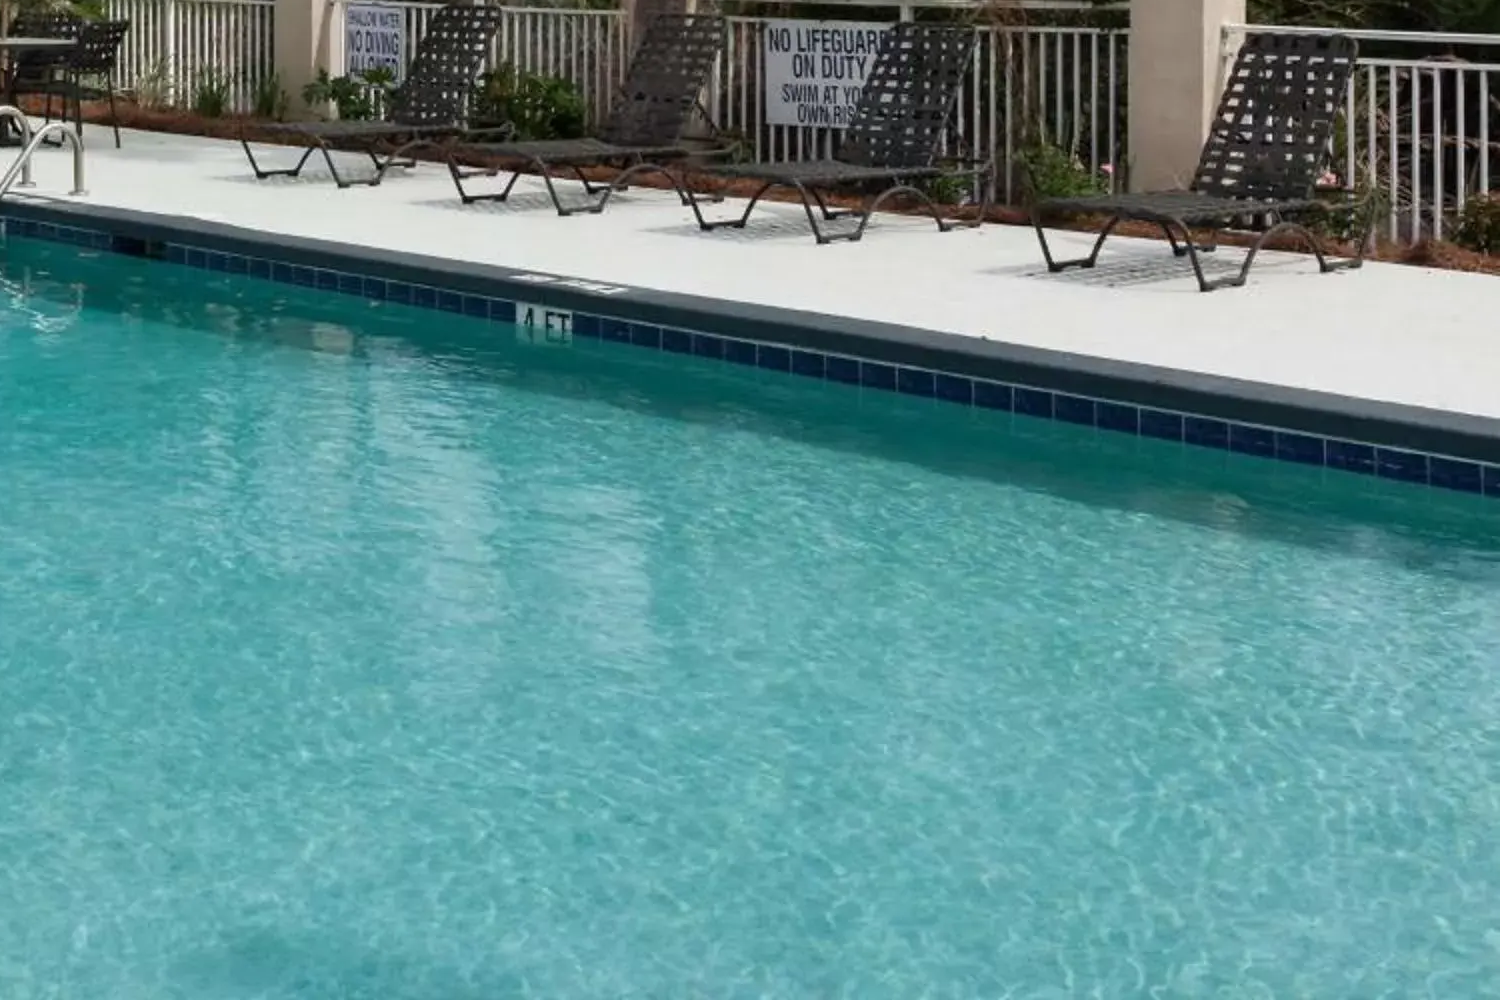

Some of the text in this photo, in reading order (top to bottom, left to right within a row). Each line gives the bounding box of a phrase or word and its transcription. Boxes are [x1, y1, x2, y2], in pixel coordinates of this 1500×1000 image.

[349, 30, 399, 55] NO DIVING
[769, 28, 791, 52] NO
[793, 54, 867, 80] ON DUTY
[782, 84, 818, 103] SWIM
[824, 86, 838, 104] AT
[798, 104, 855, 124] OWN RIS
[545, 311, 570, 331] FT
